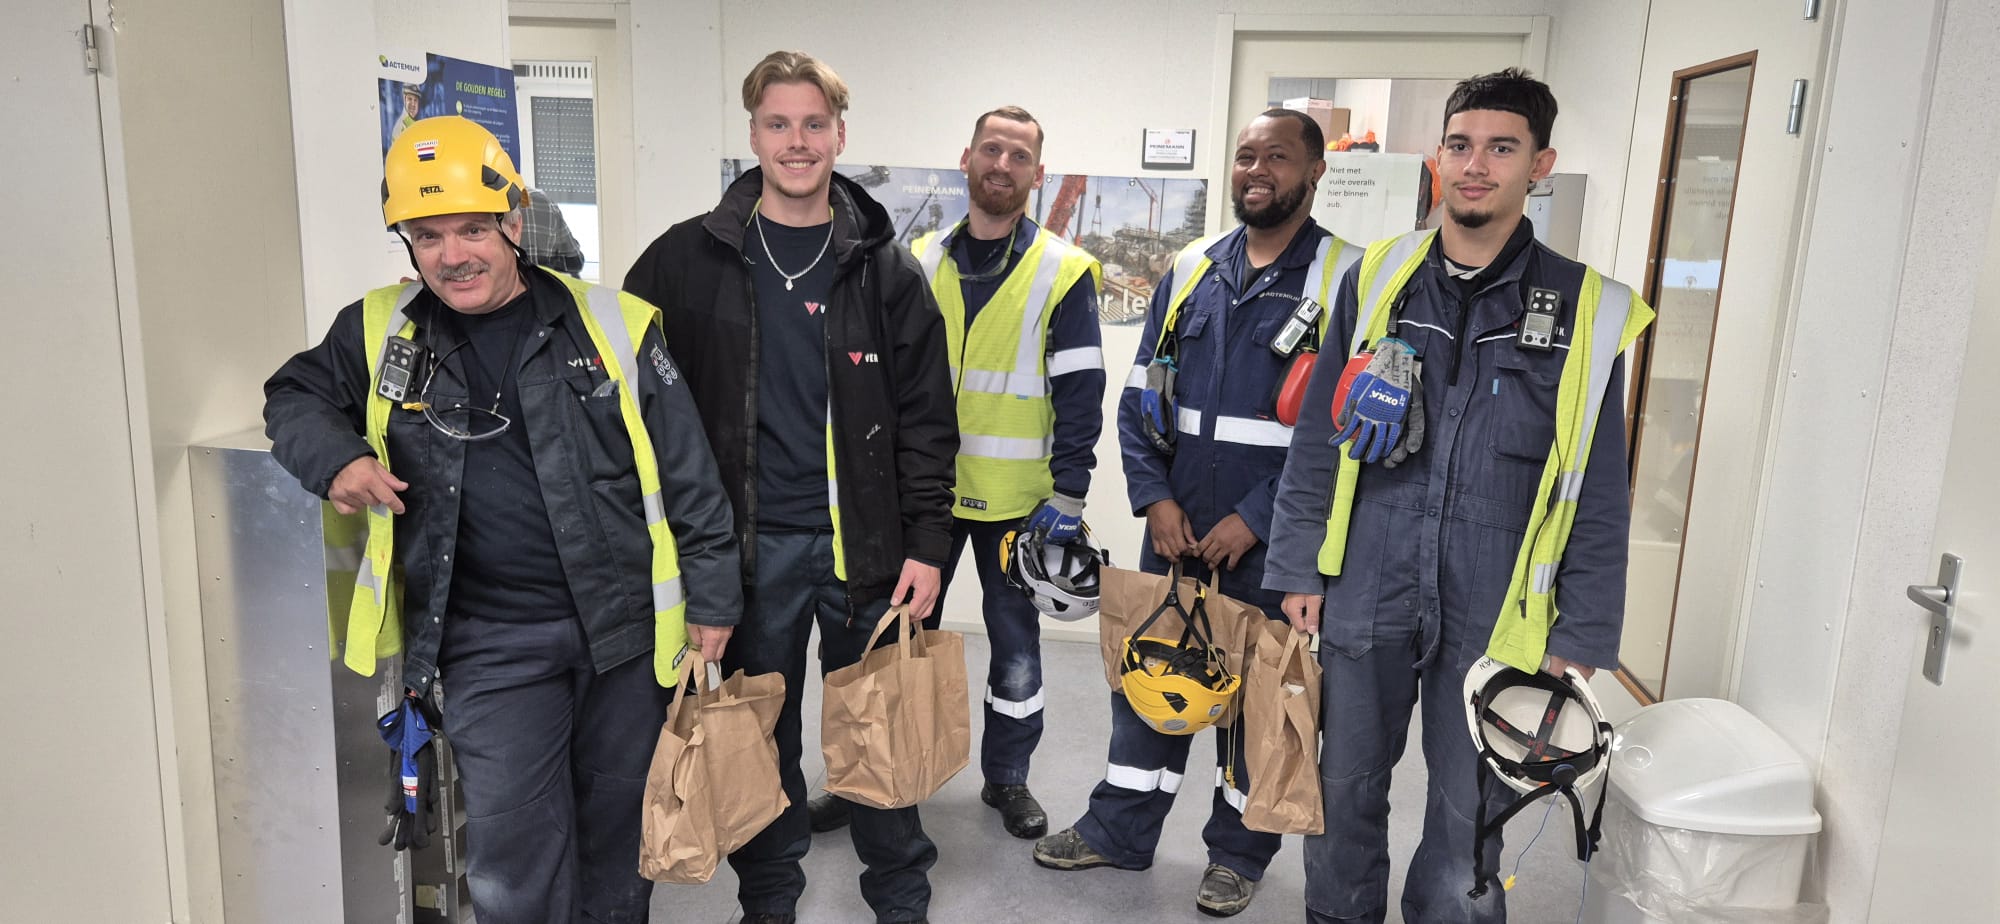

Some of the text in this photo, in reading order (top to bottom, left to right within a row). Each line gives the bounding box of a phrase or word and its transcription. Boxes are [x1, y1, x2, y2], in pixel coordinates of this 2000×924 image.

[389, 60, 420, 72] ACTEMIUM
[456, 81, 506, 98] DE GOUDEN REGELS
[1347, 179, 1376, 187] overalls
[903, 186, 964, 195] PEINEMANN
[865, 353, 879, 363] VER
